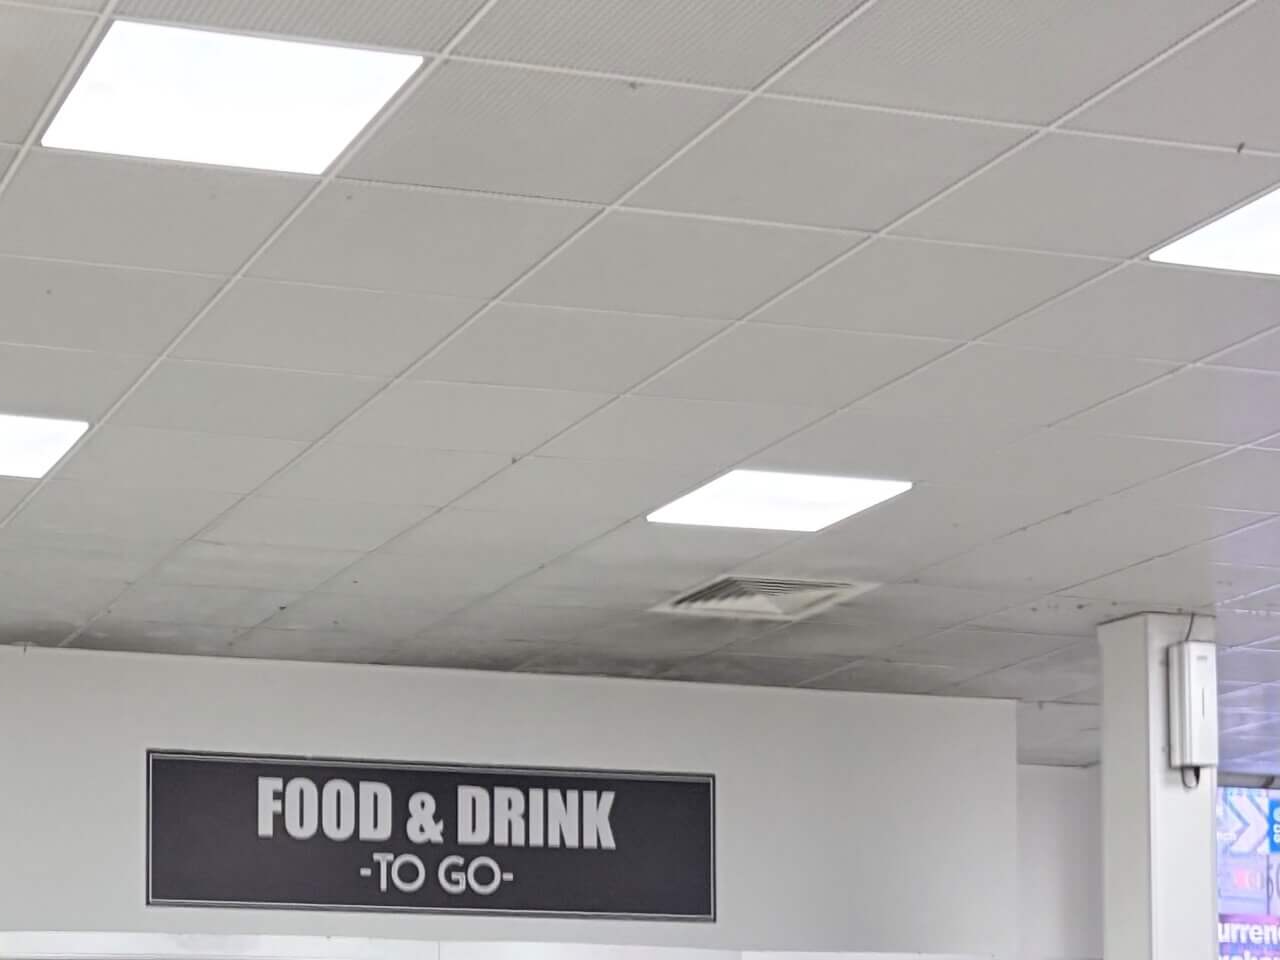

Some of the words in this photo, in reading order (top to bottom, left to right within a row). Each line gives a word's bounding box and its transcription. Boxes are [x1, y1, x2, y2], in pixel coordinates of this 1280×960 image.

[257, 776, 393, 841] FOOD
[406, 791, 444, 844] &
[457, 785, 616, 850] DRINK
[1218, 922, 1280, 944] urren
